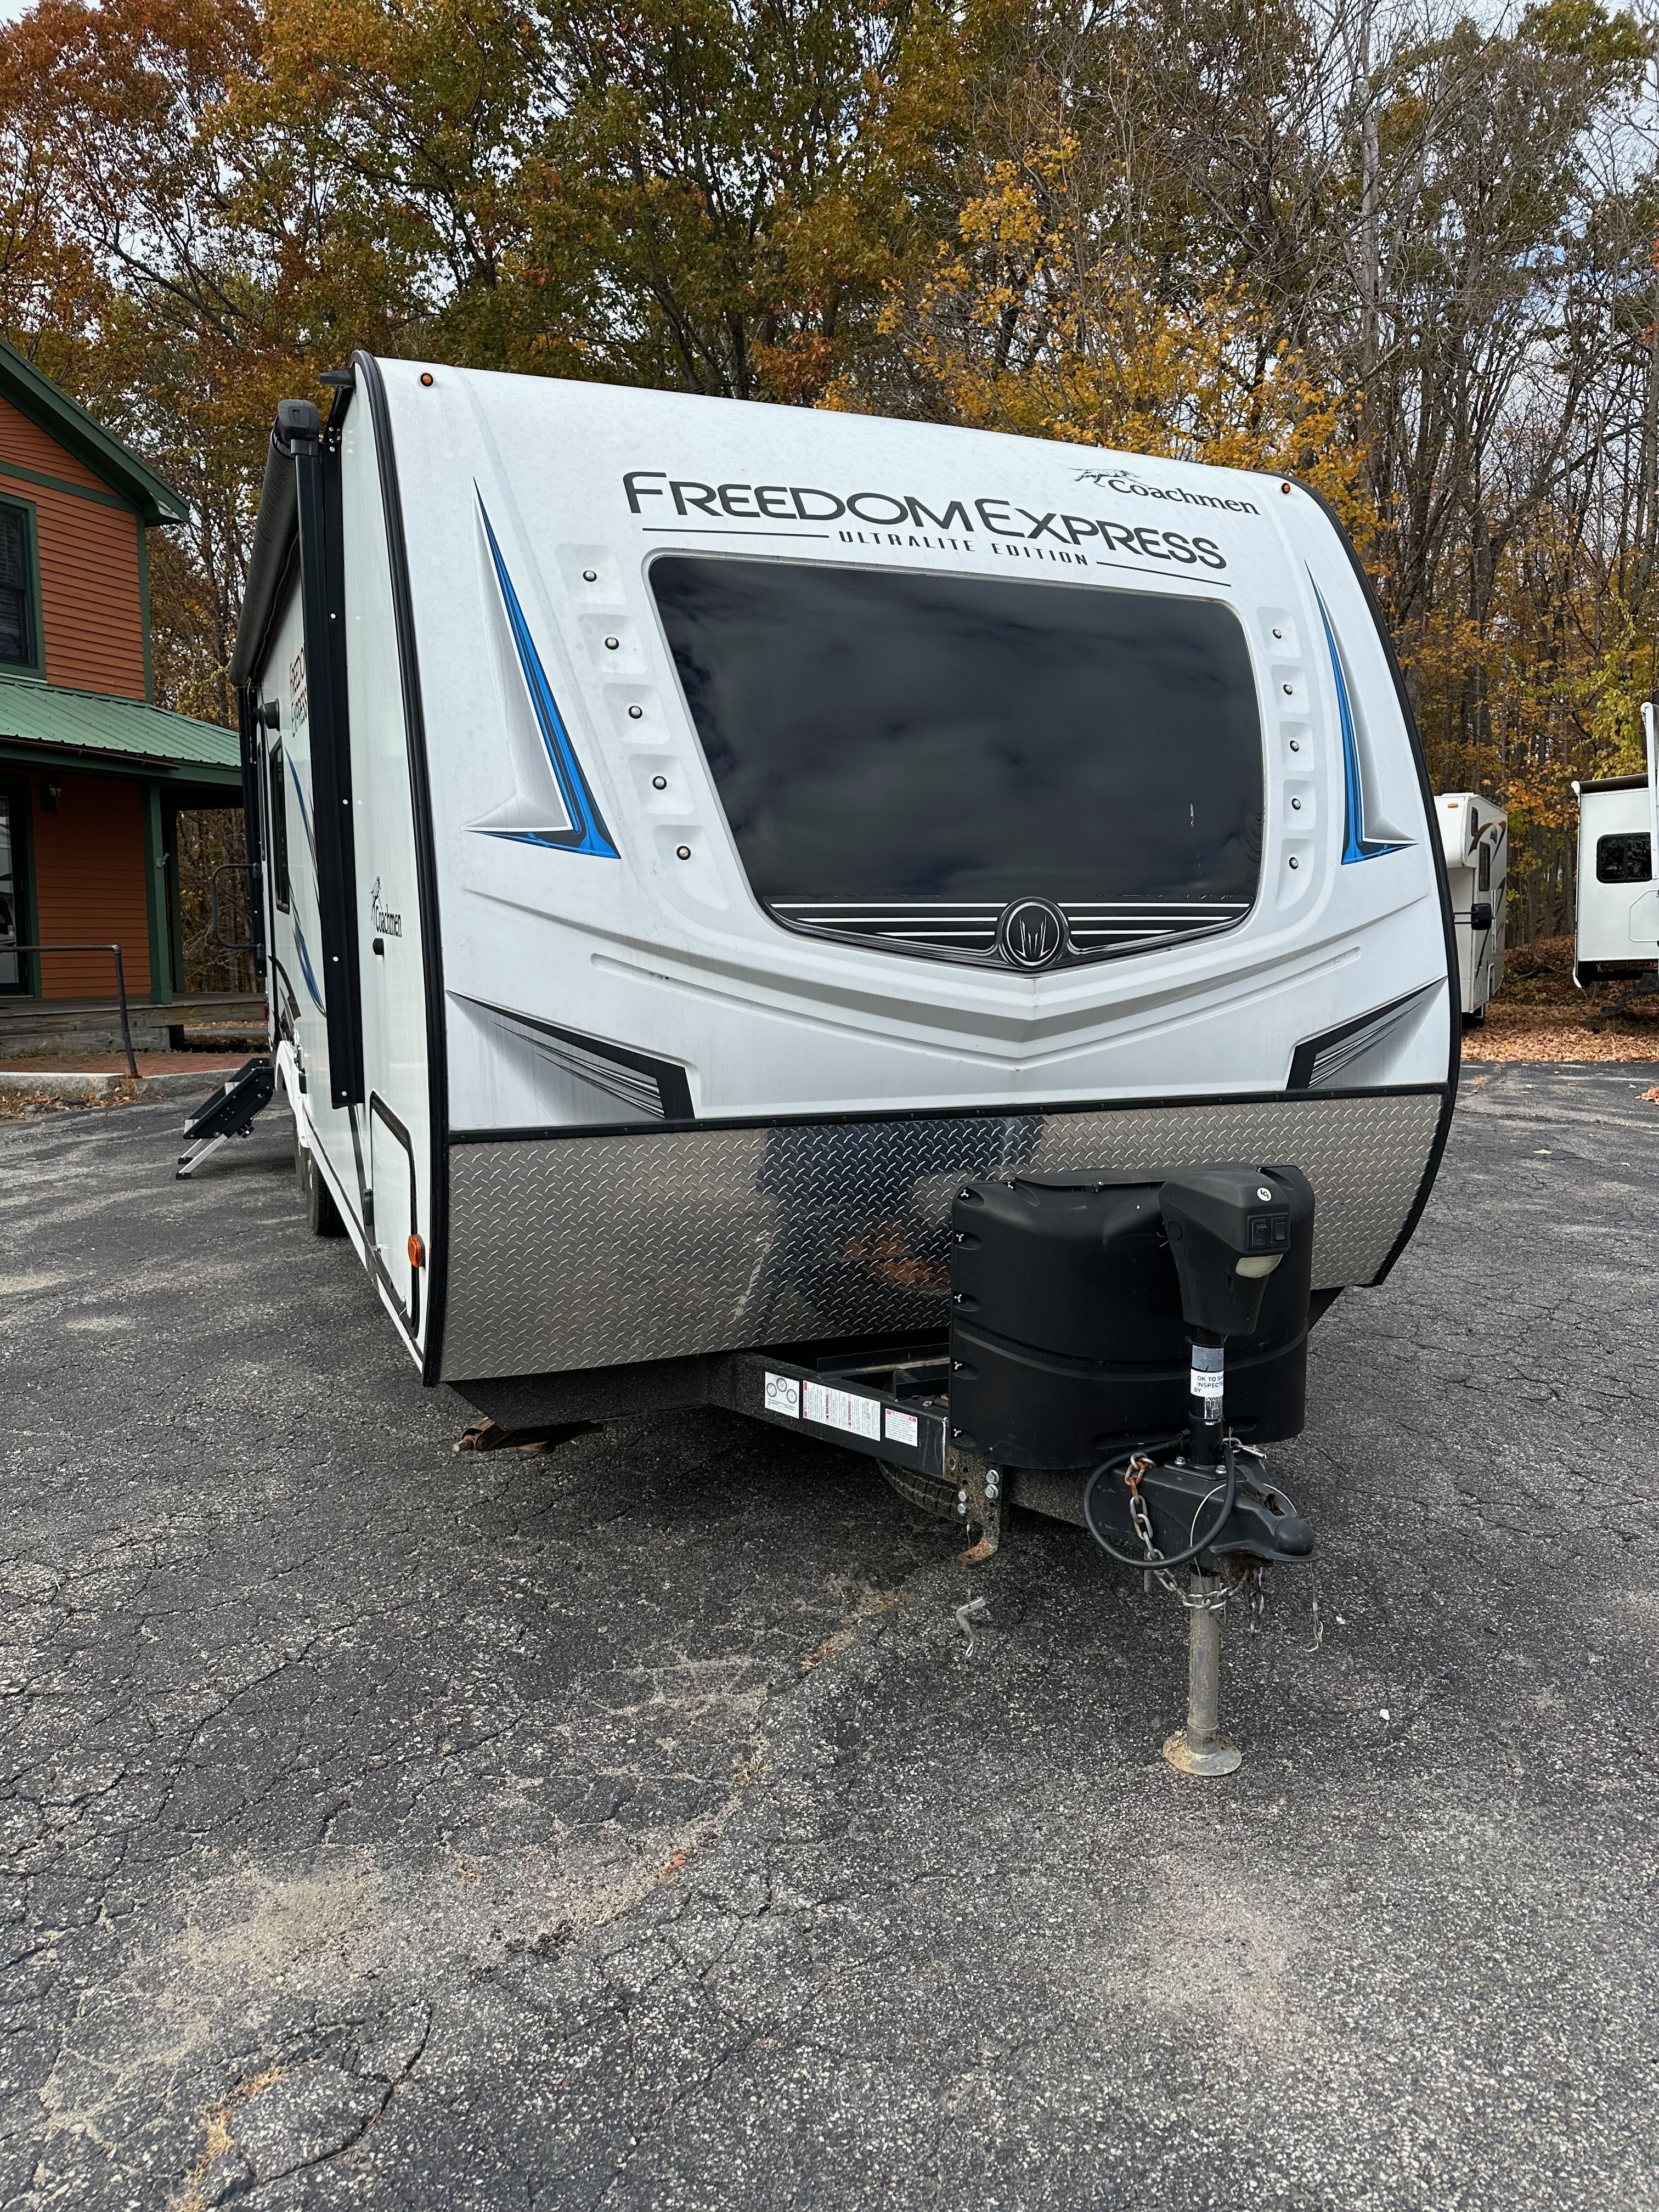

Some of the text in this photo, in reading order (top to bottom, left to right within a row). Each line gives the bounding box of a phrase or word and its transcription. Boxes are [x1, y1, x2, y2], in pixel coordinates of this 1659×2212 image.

[1108, 479, 1261, 515] Coachmen
[839, 530, 1088, 565] ULTRALITE EDITION
[289, 647, 306, 701] FREEDO
[375, 903, 402, 938] Coachmen
